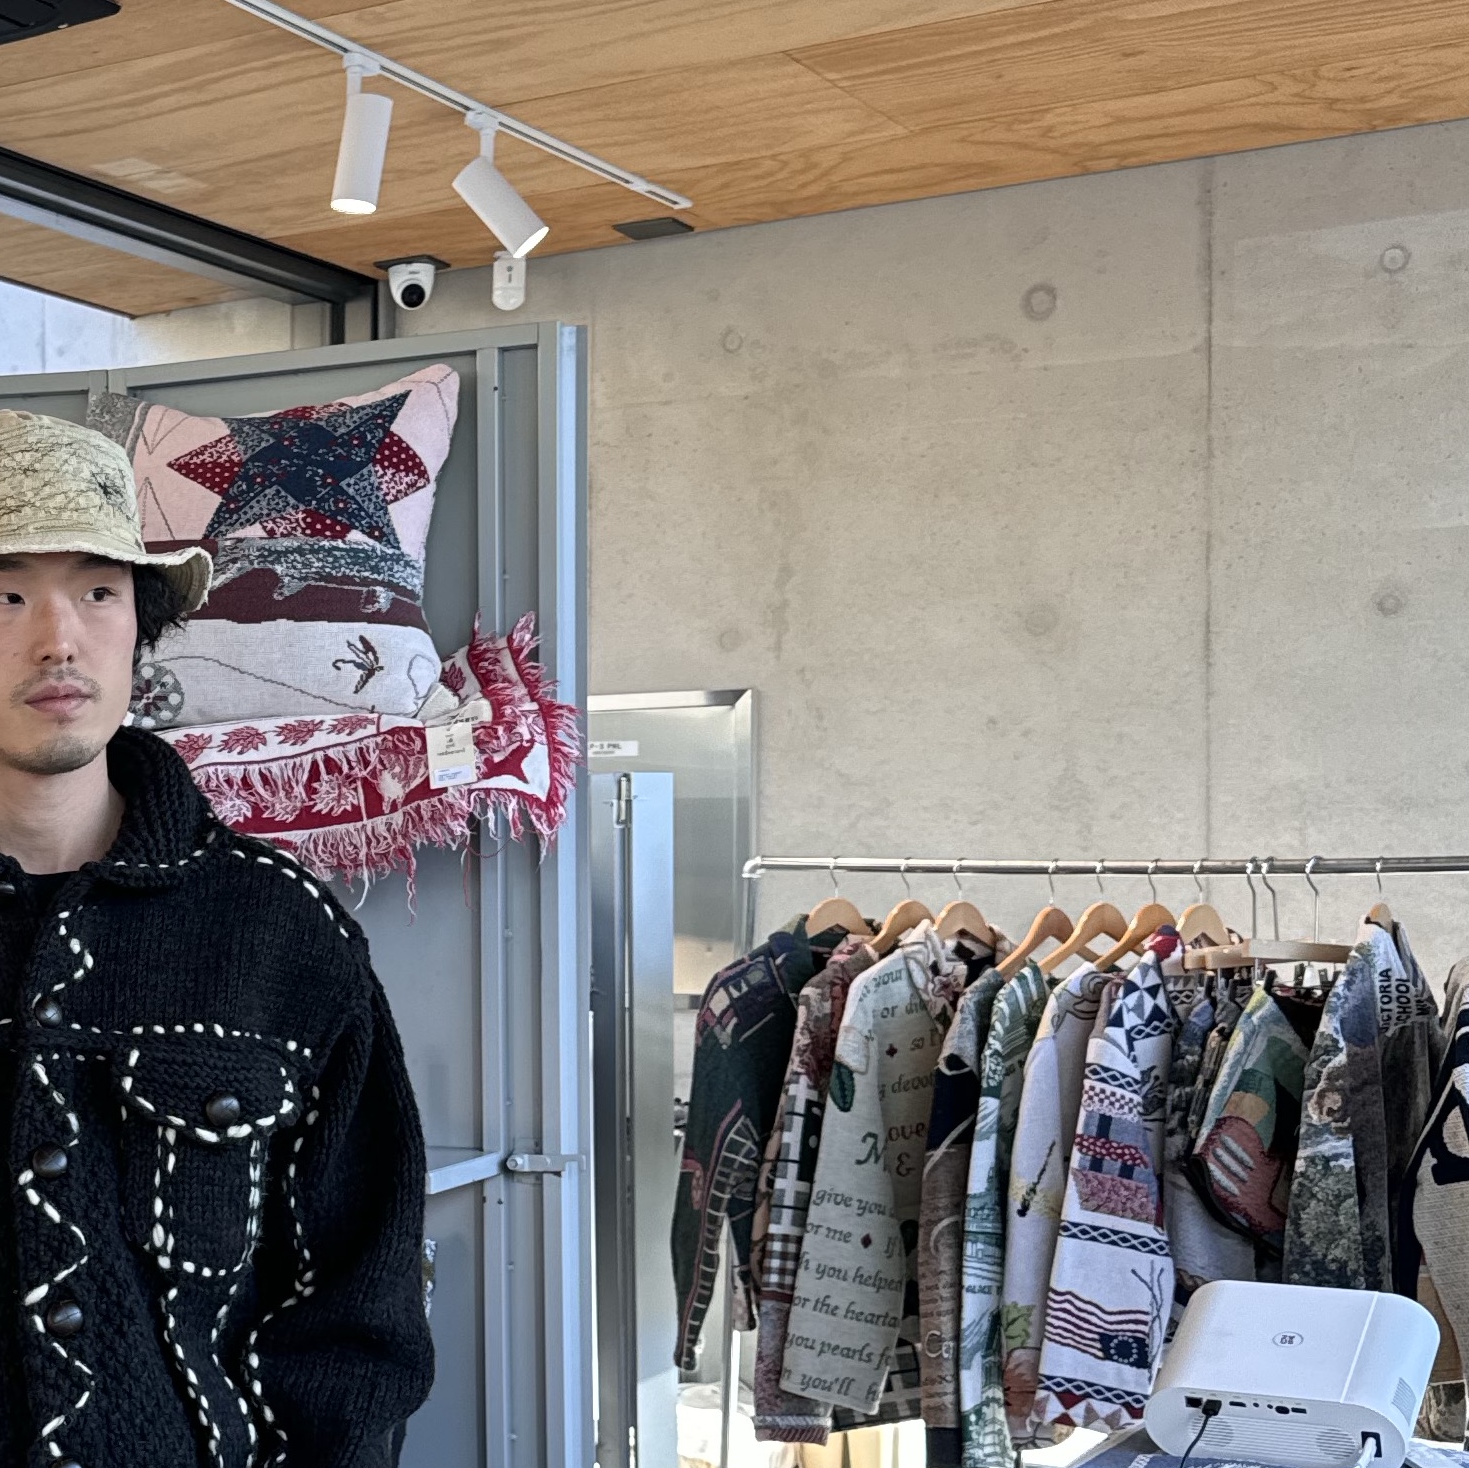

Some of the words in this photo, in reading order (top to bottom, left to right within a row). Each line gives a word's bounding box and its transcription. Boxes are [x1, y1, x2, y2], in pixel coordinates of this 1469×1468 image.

[813, 1188, 853, 1207] give
[825, 1226, 853, 1244] me
[815, 1263, 849, 1282] you
[813, 1294, 840, 1317] the
[818, 1341, 875, 1364] pearls
[799, 1373, 857, 1397] you'll
